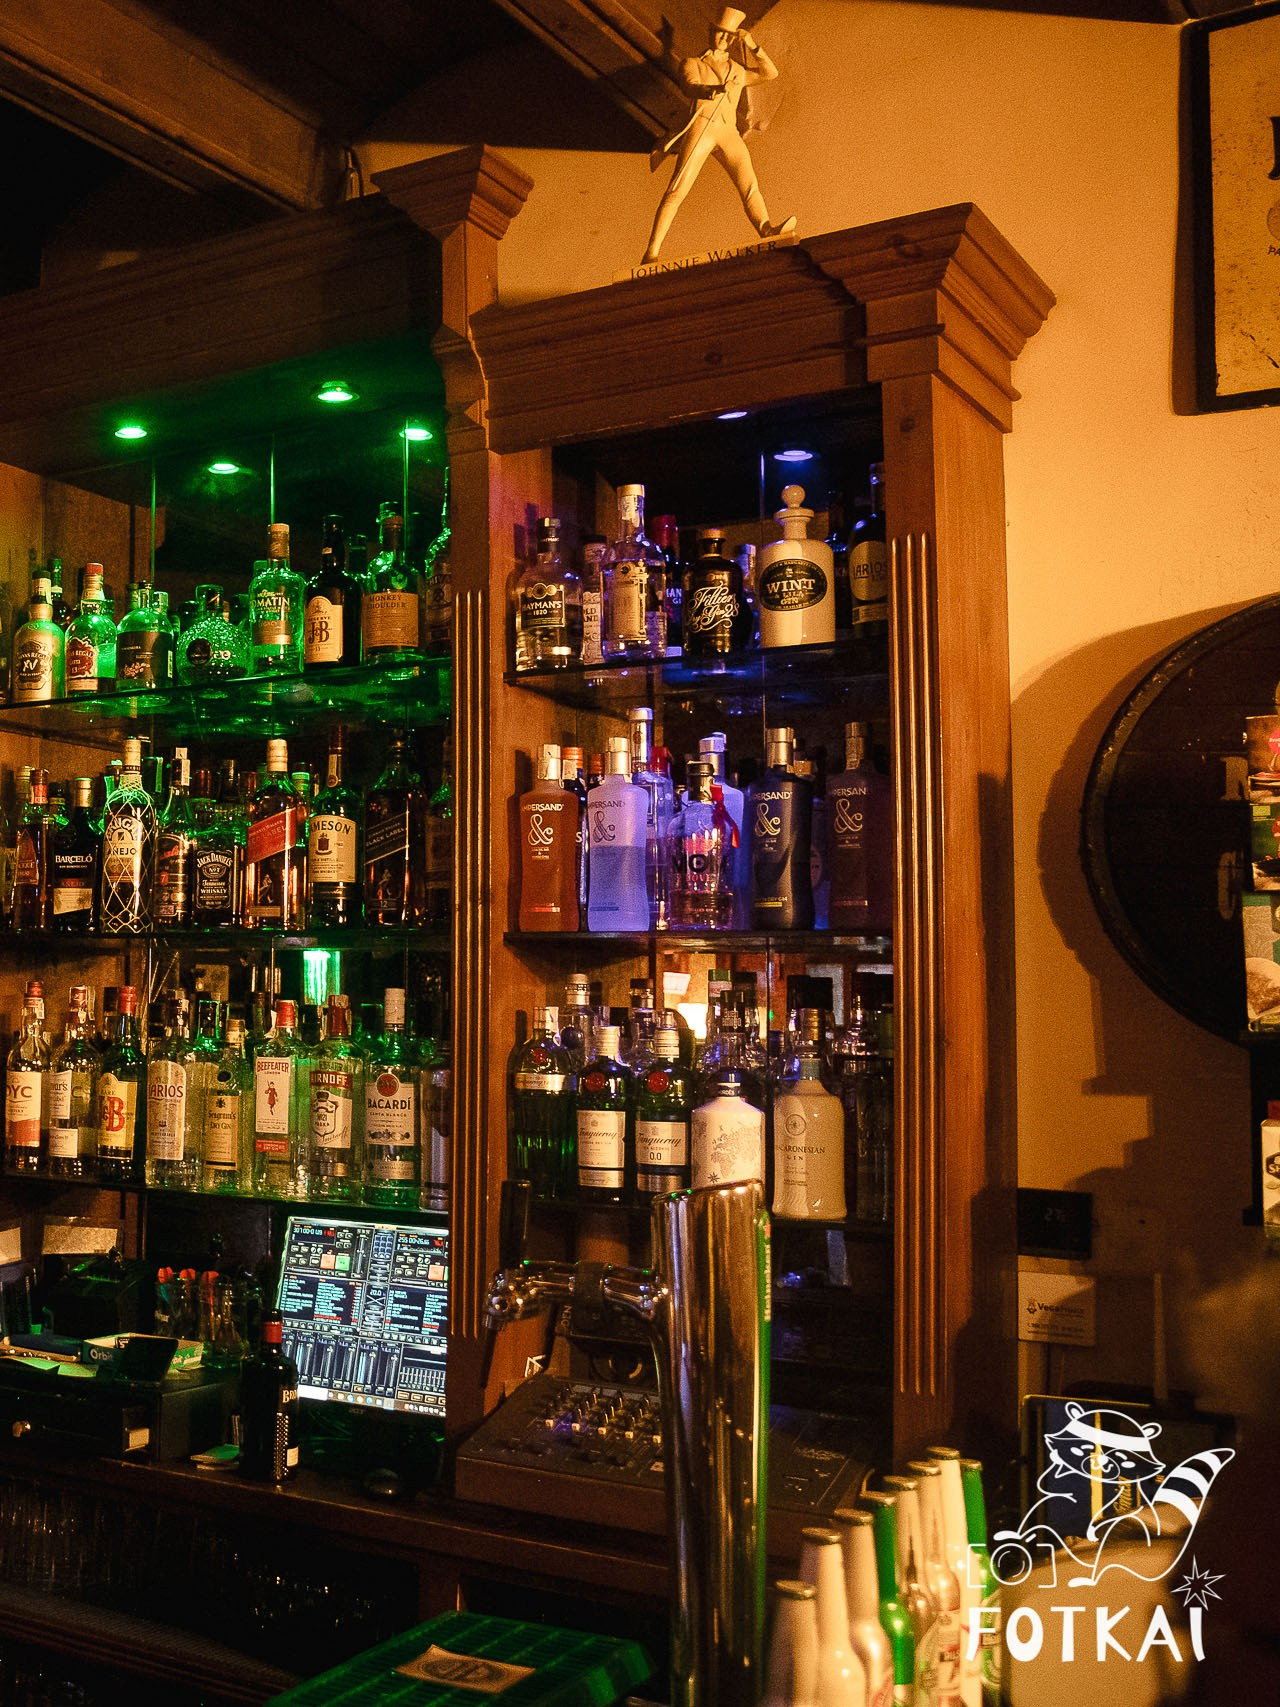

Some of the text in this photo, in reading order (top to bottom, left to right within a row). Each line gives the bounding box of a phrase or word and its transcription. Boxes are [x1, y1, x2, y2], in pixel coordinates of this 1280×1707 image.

[631, 240, 777, 281] JOHNNIE WALKER
[767, 578, 816, 593] WINT
[368, 601, 406, 609] HOULDER
[523, 600, 562, 610] AYMAN'S
[22, 658, 39, 672] XV
[55, 853, 93, 865] BARCELÓ
[196, 852, 233, 869] JACK DANIEL'S
[256, 1061, 290, 1073] BEEFEATER
[367, 1097, 411, 1110] BACARDÍ
[638, 1133, 682, 1147] Tanqueray
[649, 1151, 662, 1161] 0.0
